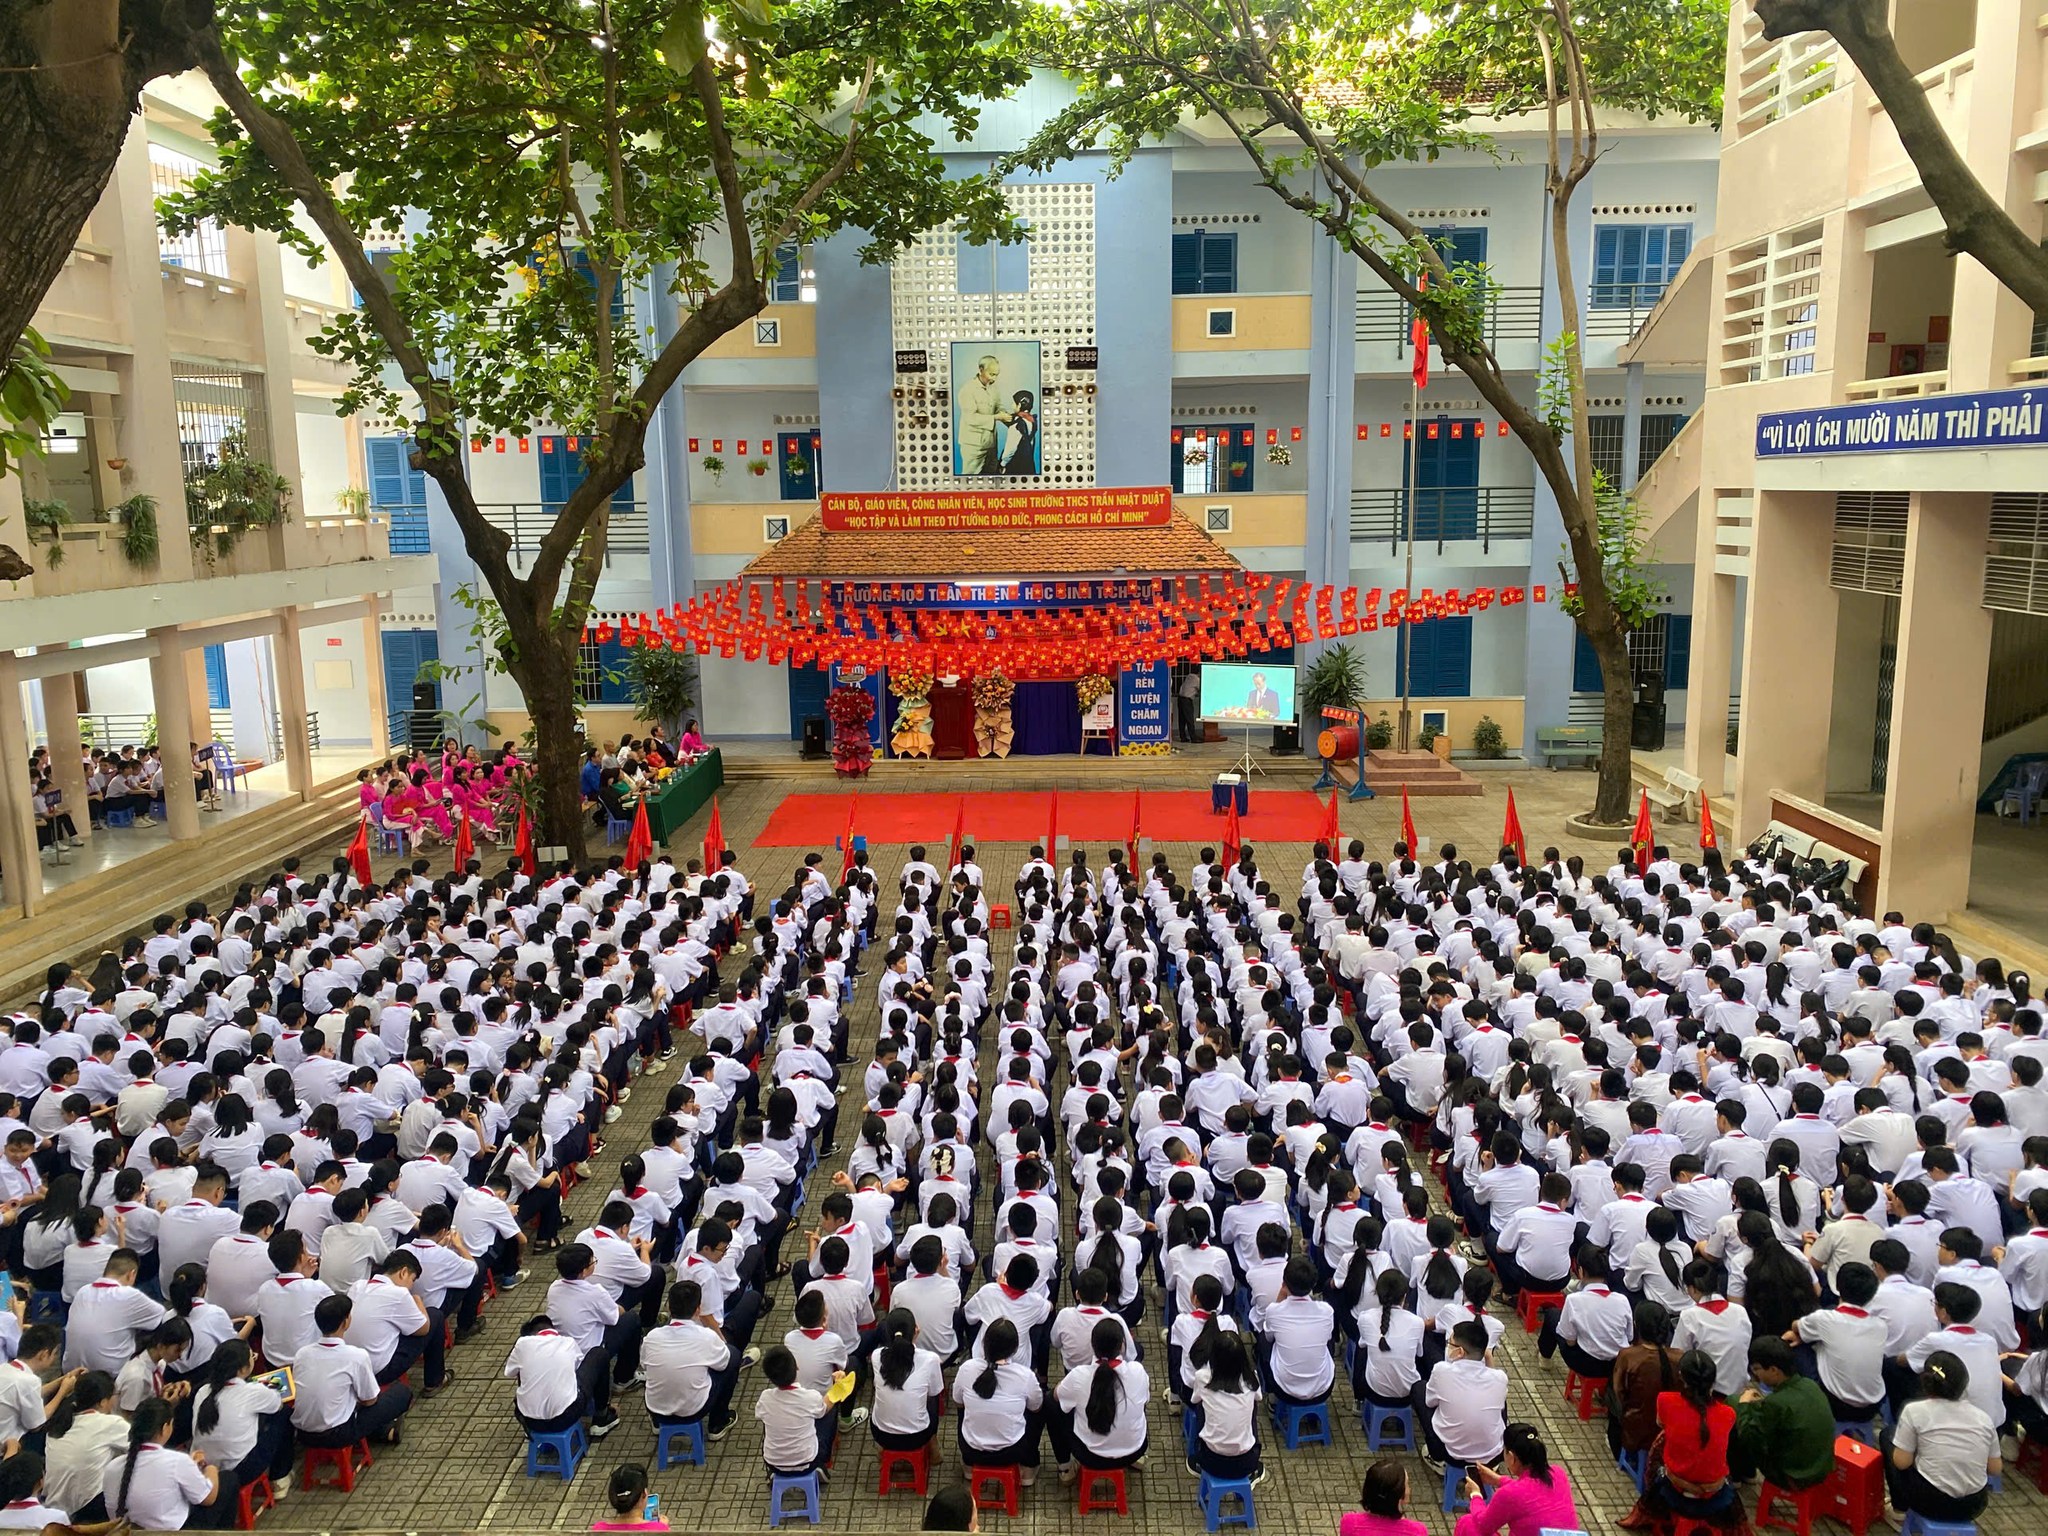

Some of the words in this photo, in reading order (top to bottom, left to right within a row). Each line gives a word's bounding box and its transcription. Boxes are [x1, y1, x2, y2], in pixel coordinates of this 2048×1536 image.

[1787, 423, 1811, 452] LỢI
[1815, 416, 1841, 447] ÍCH
[1846, 410, 1891, 445] MƯỜI
[1895, 408, 1937, 442] NĂM
[1945, 401, 1980, 440] THÌ
[1986, 392, 2043, 438] PHẢI
[828, 497, 845, 511] CÁN
[848, 497, 862, 512] BỘ,
[865, 497, 885, 511] GIÁO
[887, 496, 910, 511] VIÊN,
[912, 496, 935, 510] CÔNG
[937, 496, 960, 509] NHÂN
[963, 496, 985, 510] VIÊN,
[988, 497, 1005, 510] HỌC
[1008, 497, 1027, 508] SINH
[1030, 494, 1064, 508] TRƯỜNG
[1066, 495, 1088, 507] THCS
[1117, 492, 1139, 507] NHẬT
[1142, 491, 1165, 506] DUẬT
[869, 514, 886, 529] TẬP
[888, 514, 899, 527] VÀ
[902, 514, 921, 527] LÀM
[923, 516, 945, 527] THEO
[948, 514, 960, 526] TƯ
[961, 511, 990, 526] TƯỞNG
[992, 514, 1009, 527] ĐẠO
[1035, 513, 1063, 525] PHONG
[1065, 510, 1088, 524] CÁCH
[1105, 510, 1119, 523] CHÍ
[929, 586, 966, 601] TÂN
[1025, 587, 1053, 602] HC
[1096, 585, 1128, 599] TCH
[1130, 692, 1161, 706] LUYỆN
[1131, 706, 1159, 720] CHĂM
[1128, 725, 1162, 735] NGOAN
